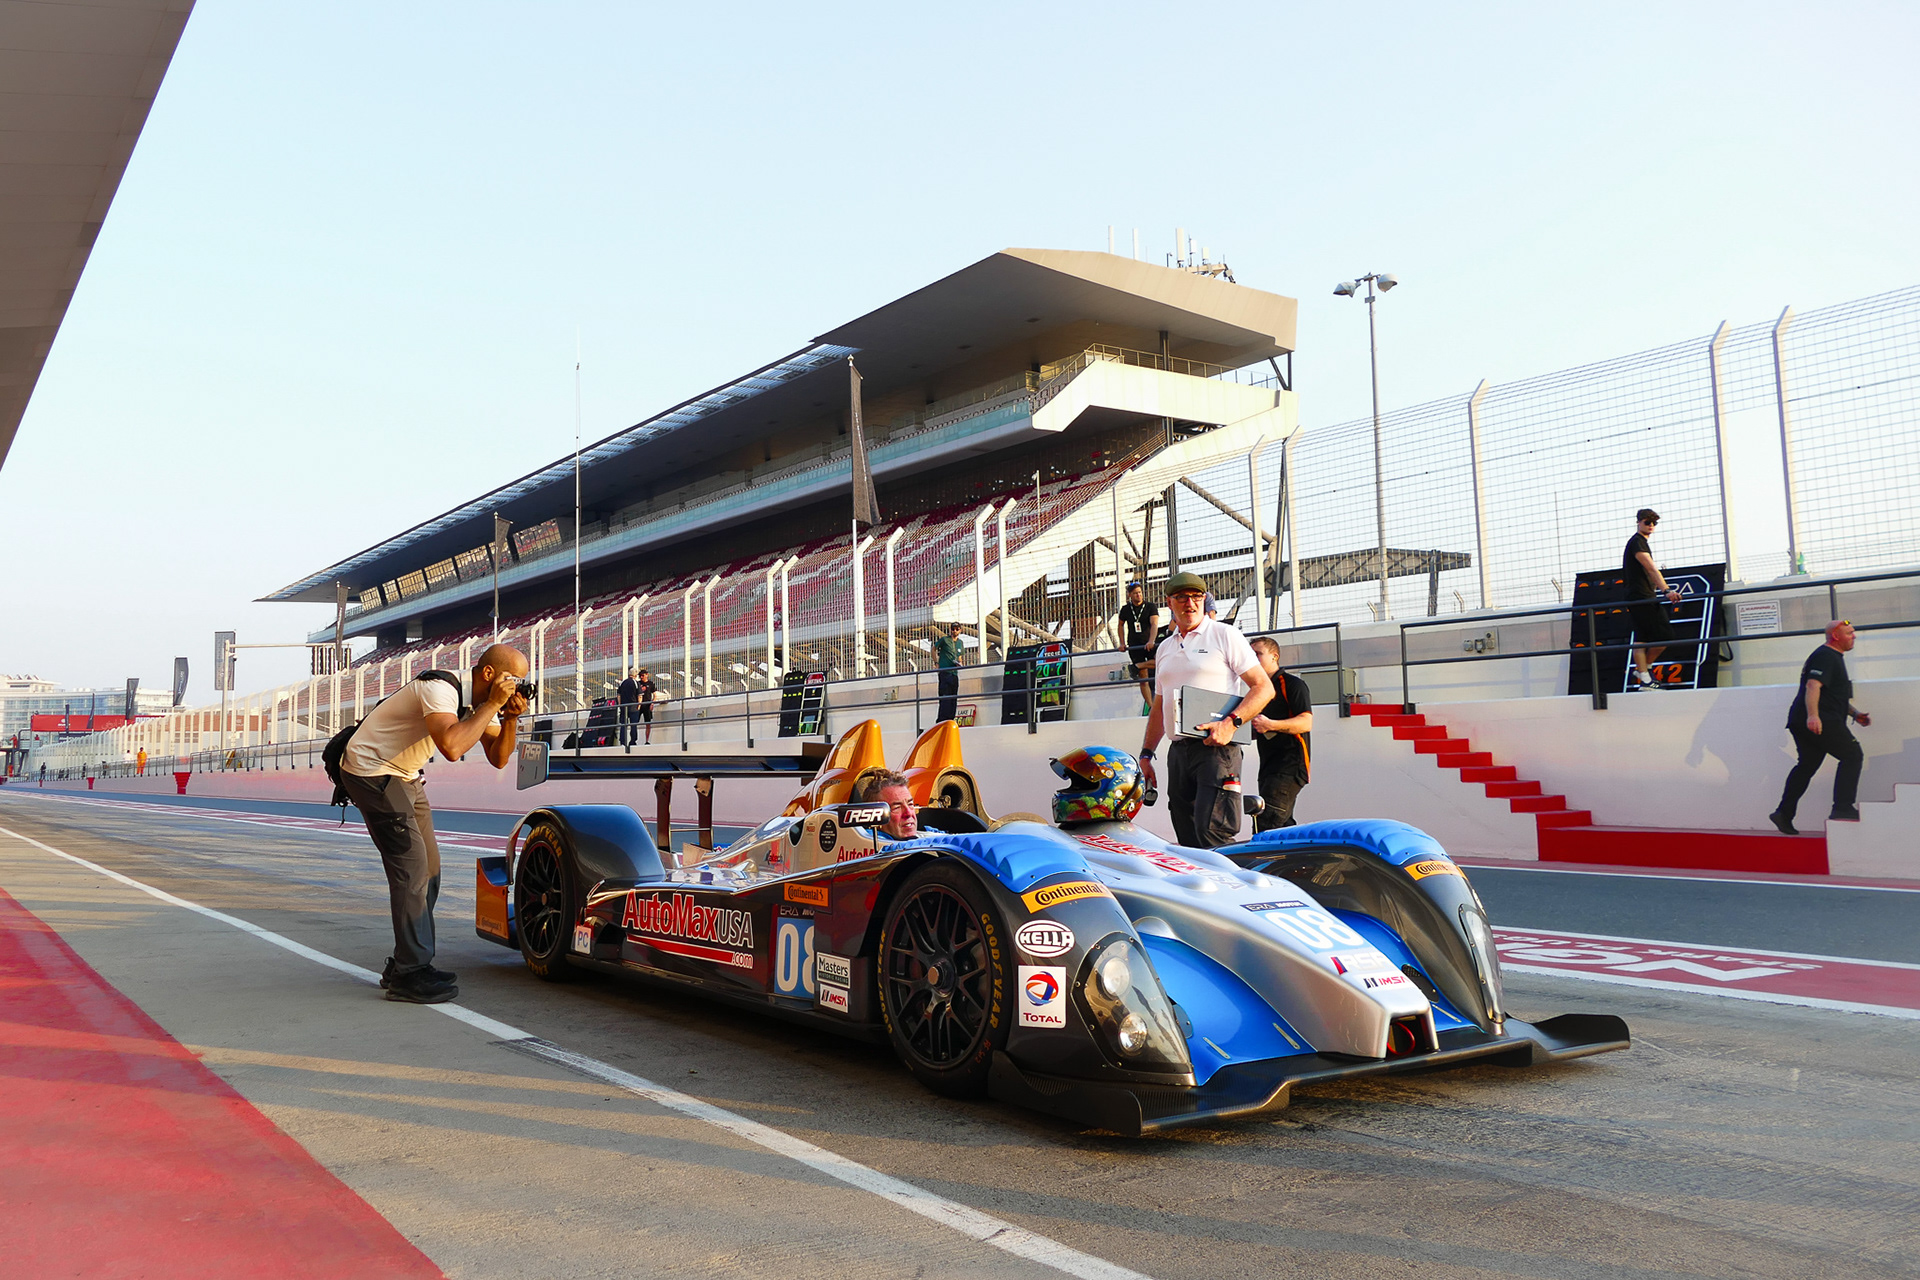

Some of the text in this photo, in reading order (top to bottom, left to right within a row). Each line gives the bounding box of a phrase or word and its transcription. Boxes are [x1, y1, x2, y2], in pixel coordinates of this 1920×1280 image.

[849, 808, 884, 823] RSR
[787, 884, 821, 901] Continental
[1034, 883, 1103, 906] Continental
[780, 904, 799, 916] ERA
[1246, 903, 1276, 911] ERA
[1265, 909, 1364, 949] 08
[577, 930, 589, 949] PC
[1020, 931, 1075, 949] HELLA
[777, 923, 815, 995] 08
[818, 956, 849, 977] Masters
[1647, 949, 1823, 970] SPARK
[1377, 976, 1409, 986] IMSA
[829, 993, 847, 1007] IMSA
[1023, 1012, 1062, 1024] TOTAL
